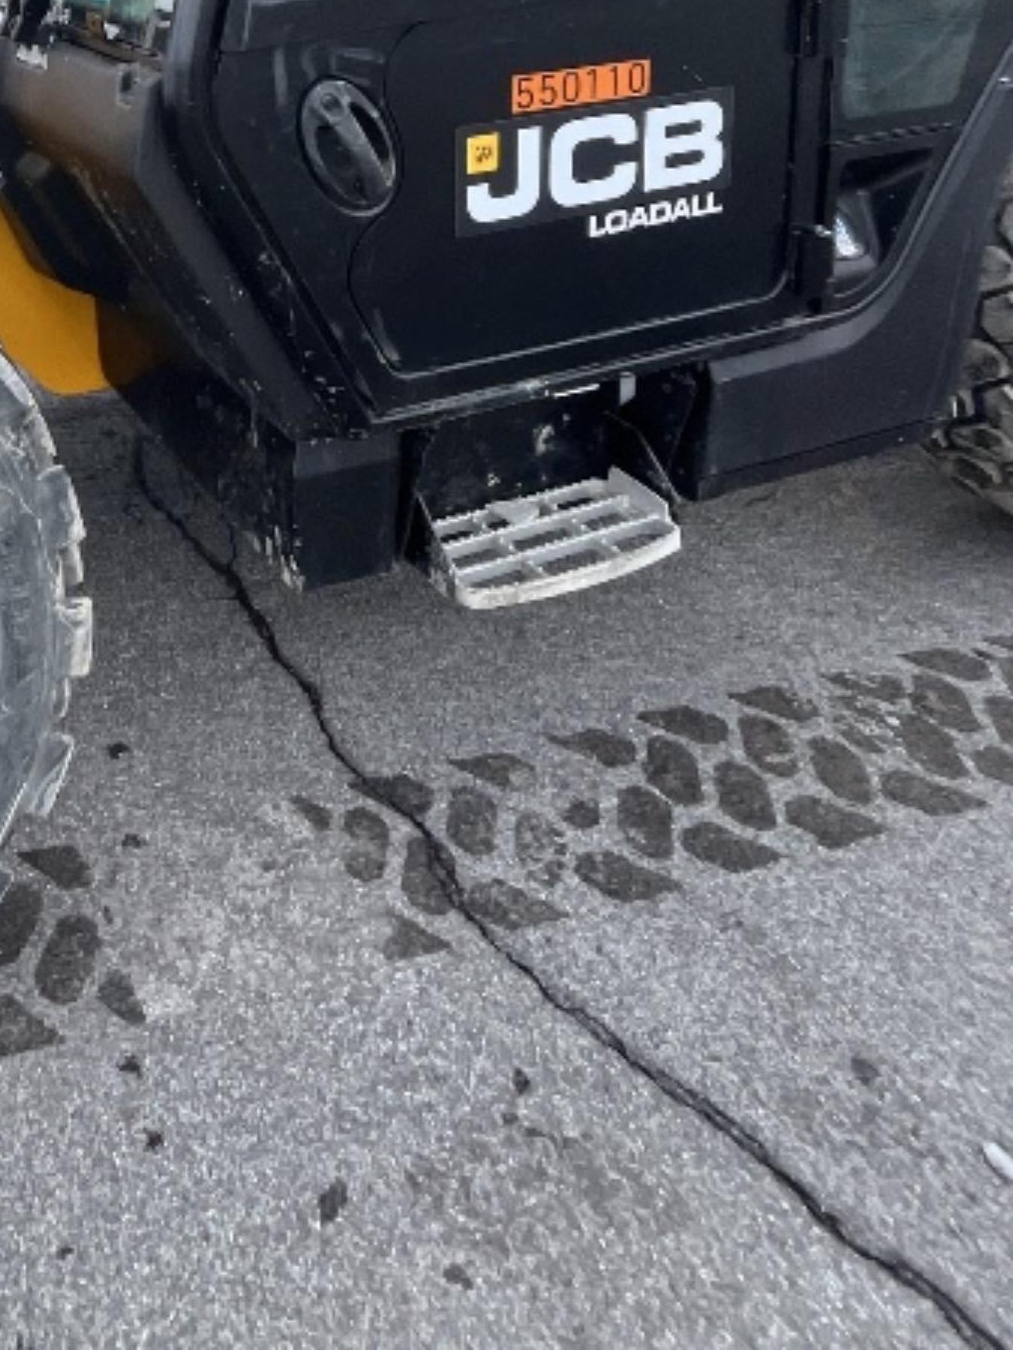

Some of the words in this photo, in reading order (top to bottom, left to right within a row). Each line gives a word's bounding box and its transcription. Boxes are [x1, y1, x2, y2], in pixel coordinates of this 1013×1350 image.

[516, 62, 647, 110] 550110
[466, 100, 724, 223] JCB
[589, 191, 723, 239] LOADALL
